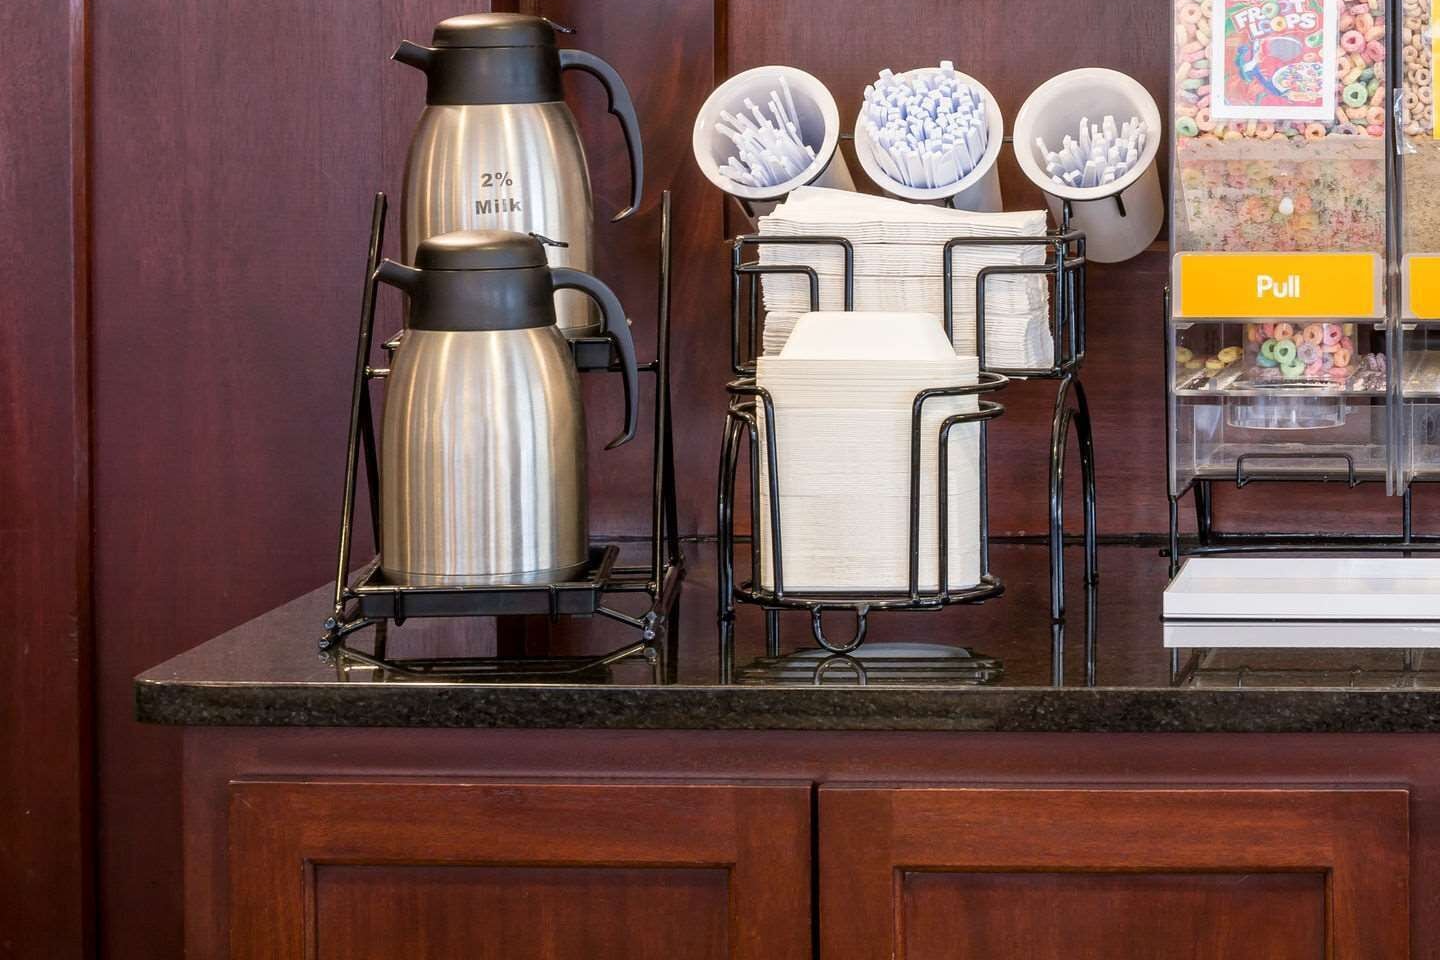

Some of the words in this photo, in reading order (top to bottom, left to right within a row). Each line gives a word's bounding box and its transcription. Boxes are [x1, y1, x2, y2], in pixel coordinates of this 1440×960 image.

[1248, 12, 1317, 38] LOOPS
[481, 171, 513, 187] 2%
[475, 198, 522, 215] Milk
[1256, 275, 1300, 298] Pull
